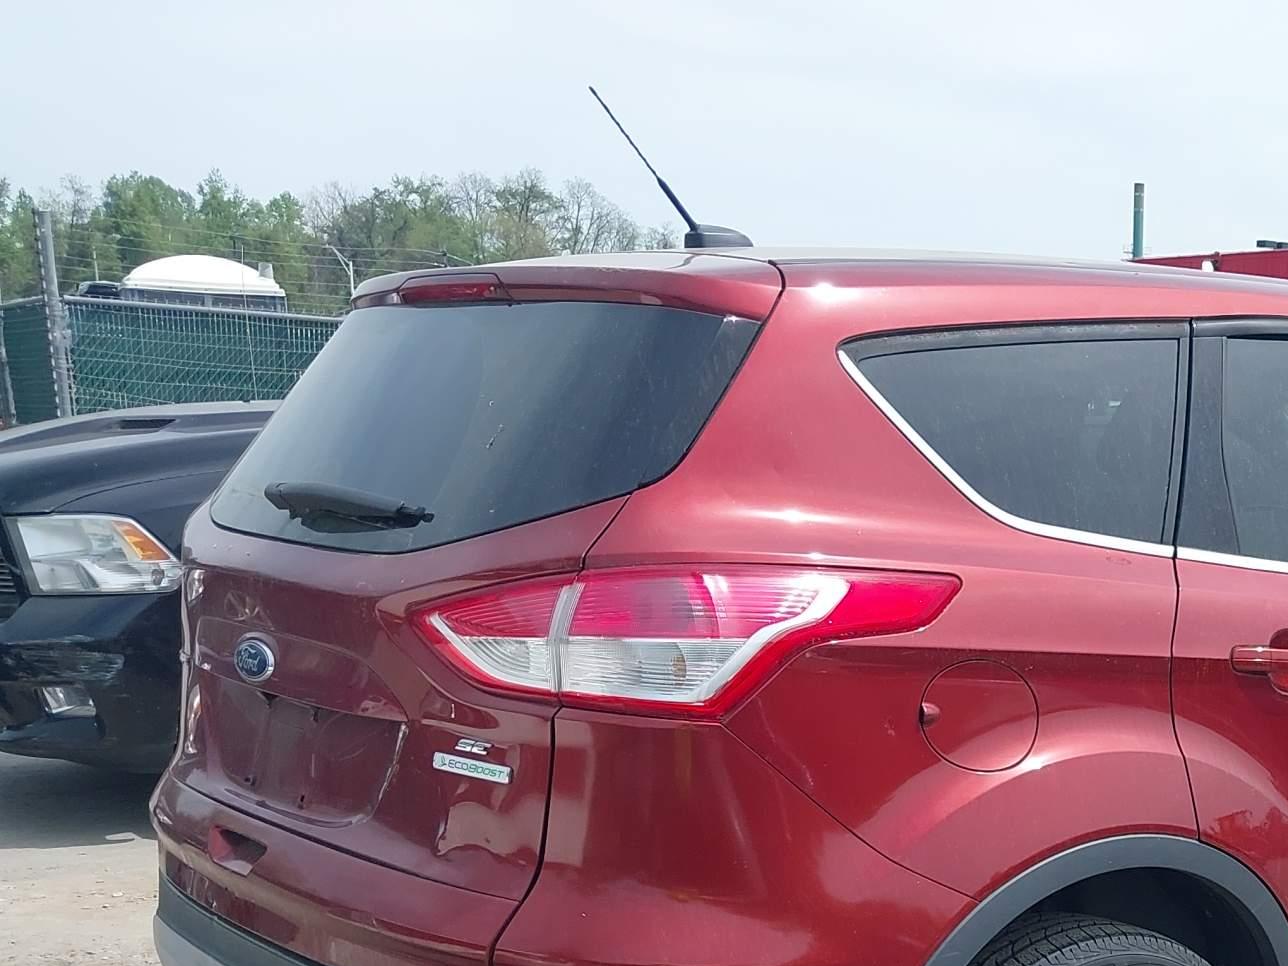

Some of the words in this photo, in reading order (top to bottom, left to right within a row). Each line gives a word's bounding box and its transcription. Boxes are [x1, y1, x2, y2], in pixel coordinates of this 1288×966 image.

[238, 646, 260, 672] Ford
[454, 739, 492, 756] SE
[447, 759, 505, 778] ECOBOOST
